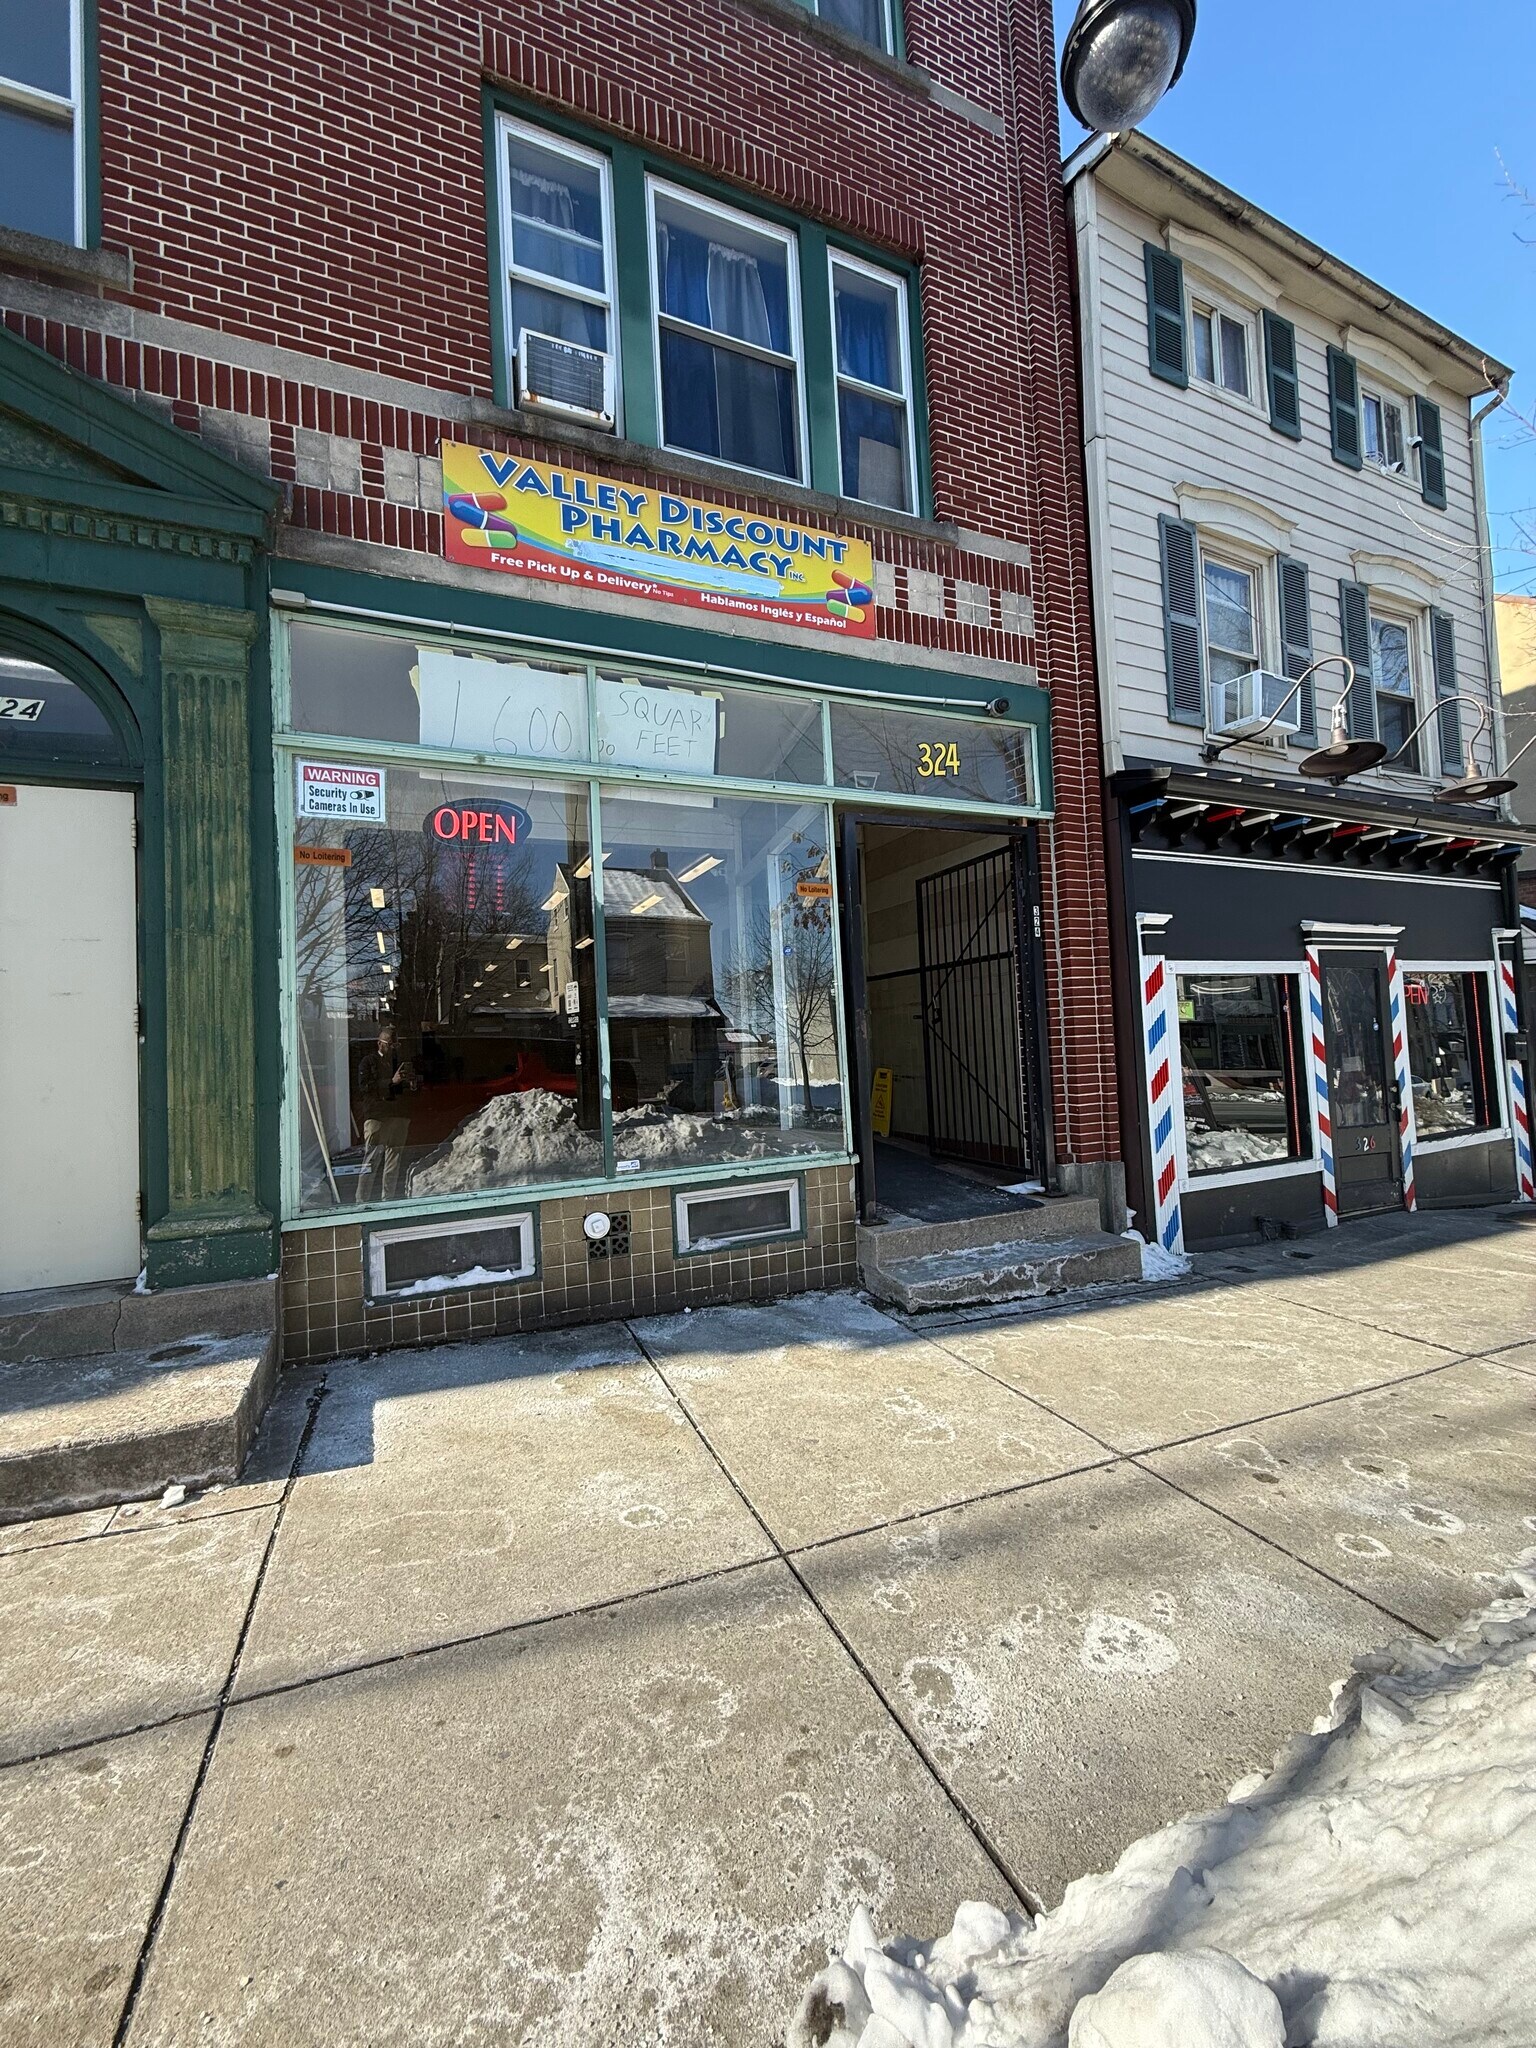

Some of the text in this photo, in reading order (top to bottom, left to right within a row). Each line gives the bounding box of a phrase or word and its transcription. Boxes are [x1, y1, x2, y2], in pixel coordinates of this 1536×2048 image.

[479, 453, 847, 563] VALLEY DISCOUNT
[561, 502, 793, 579] PHARMACY
[491, 552, 524, 568] Free
[527, 559, 557, 574] Pick
[560, 566, 580, 579] Up
[583, 570, 594, 581] &
[662, 589, 674, 597] Tips
[701, 592, 847, 629] Hablamos Inglés y Español
[611, 690, 711, 737] SQUAR
[636, 729, 698, 758] FEET
[916, 742, 961, 777] 324
[307, 768, 377, 785] WARNING
[308, 785, 347, 801] Security
[309, 798, 375, 815] Cameras In Use
[433, 807, 517, 844] OPEN
[299, 850, 346, 863] No Loitering
[809, 886, 828, 895] Loitering
